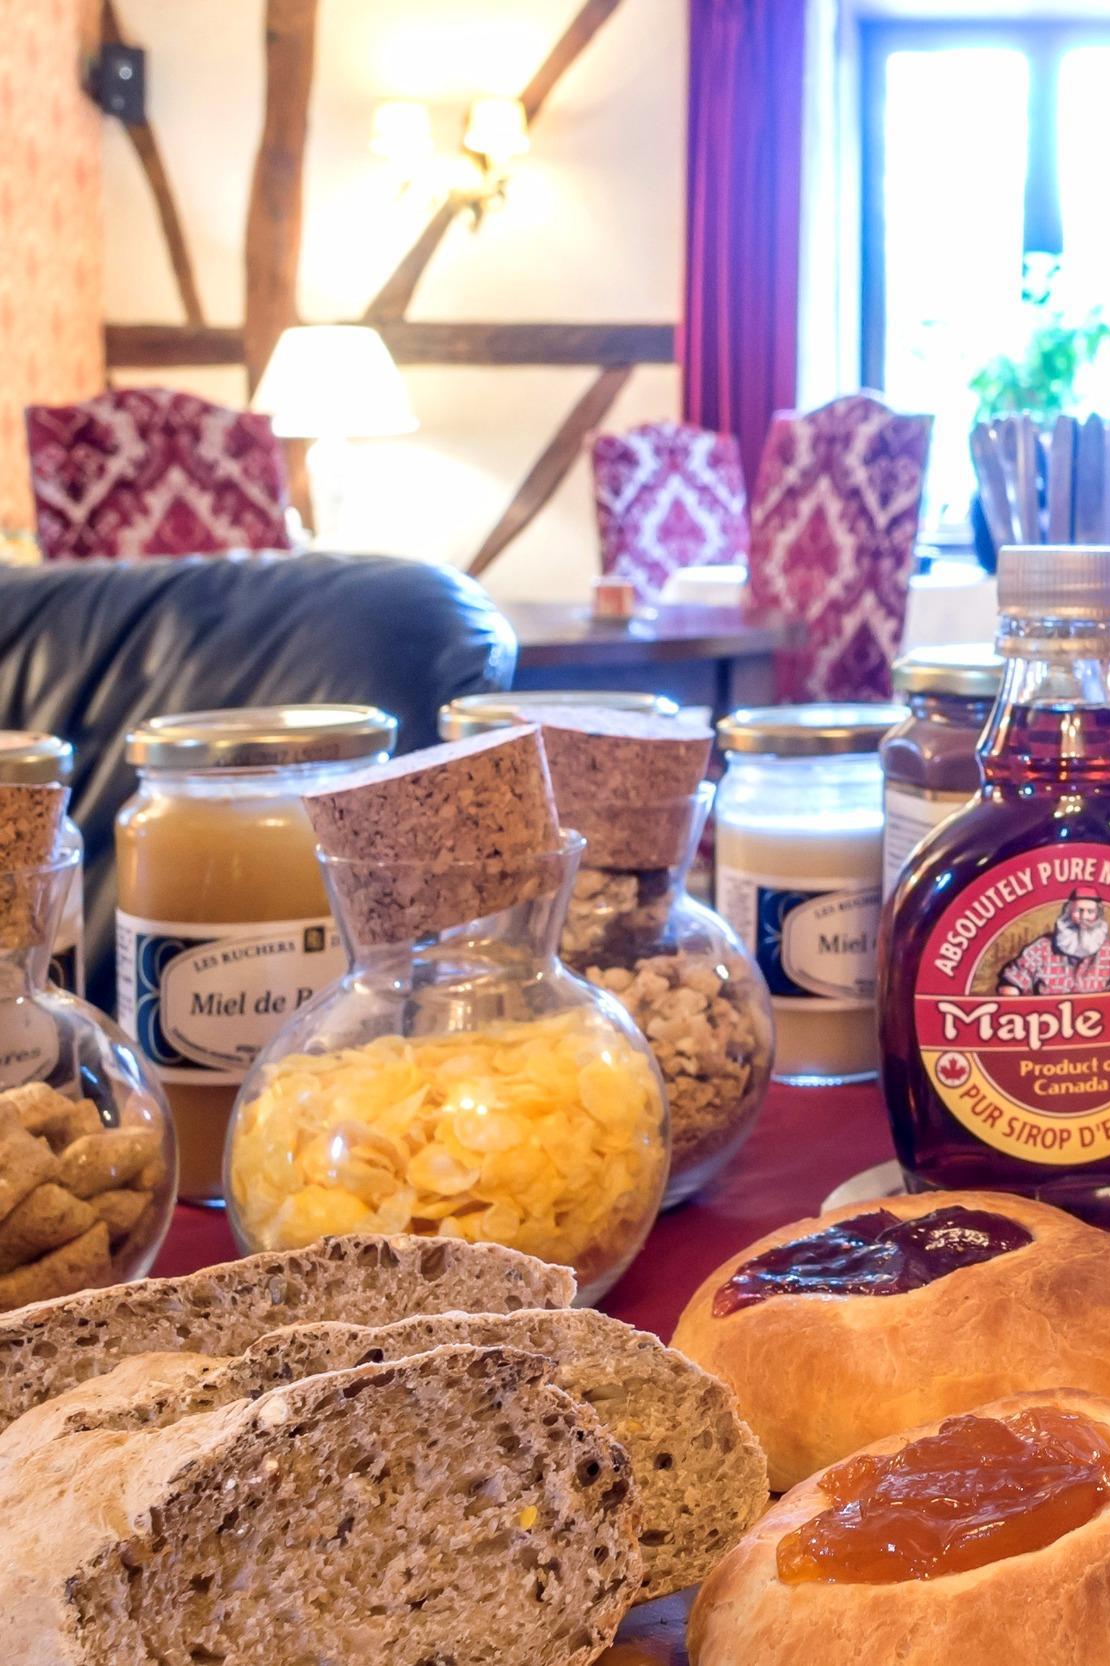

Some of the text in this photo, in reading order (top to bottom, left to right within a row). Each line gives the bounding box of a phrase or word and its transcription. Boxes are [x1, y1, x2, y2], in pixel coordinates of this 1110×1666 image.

[935, 868, 1034, 977] ABSOLUTELY
[1038, 857, 1096, 885] PURE
[818, 930, 868, 955] Miel
[190, 992, 246, 1016] Miel
[254, 993, 287, 1015] de
[937, 999, 1103, 1050] Maple
[1020, 1056, 1098, 1076] Product
[1033, 1077, 1109, 1096] Canada
[959, 1084, 1005, 1128] PUR
[1002, 1116, 1072, 1150] SIROP
